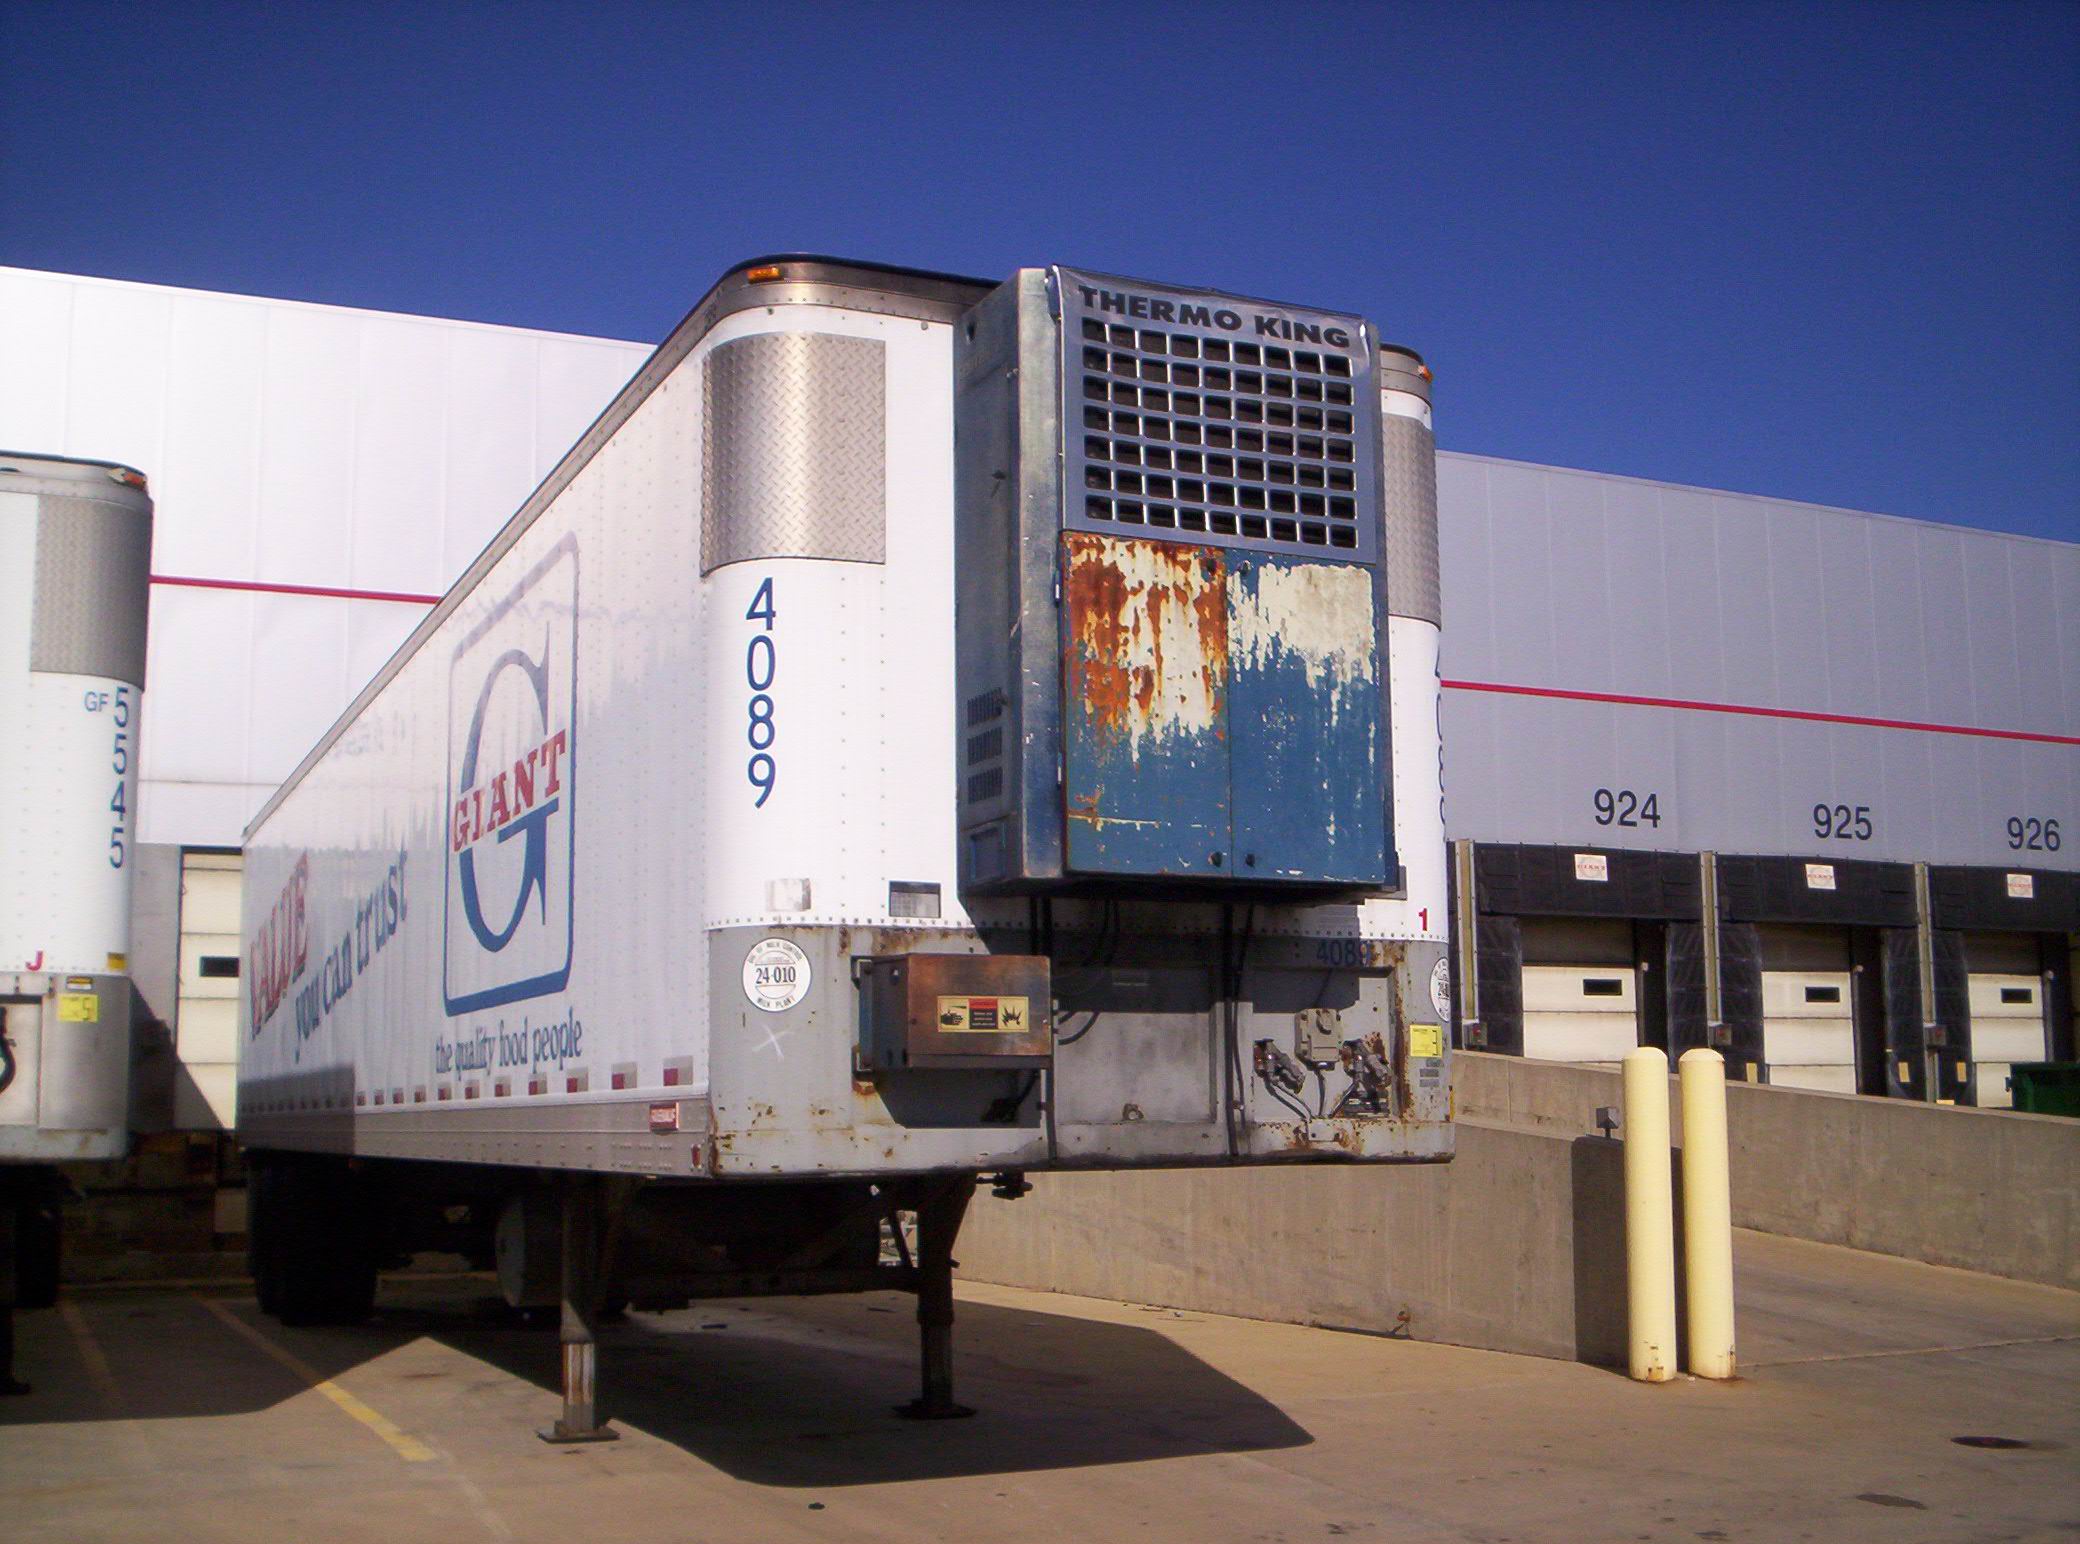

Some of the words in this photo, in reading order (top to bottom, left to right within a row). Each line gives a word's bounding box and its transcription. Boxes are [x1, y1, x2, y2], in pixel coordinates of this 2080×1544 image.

[1078, 285, 1242, 331] THERMO
[1255, 315, 1350, 348] KING
[745, 577, 776, 809] 4089
[109, 687, 128, 869] 5545
[454, 729, 566, 852] GIANT
[1594, 788, 1661, 829] 924
[1813, 803, 1873, 841] 925
[2007, 816, 2061, 852] 926
[1418, 908, 1428, 931] 1
[25, 950, 43, 971] J
[295, 973, 320, 1064] you
[323, 929, 353, 1015] can
[355, 840, 408, 975] trust
[436, 1033, 452, 1073] the
[455, 1025, 496, 1081] quality
[498, 1016, 528, 1067] food
[533, 1006, 582, 1074] people
